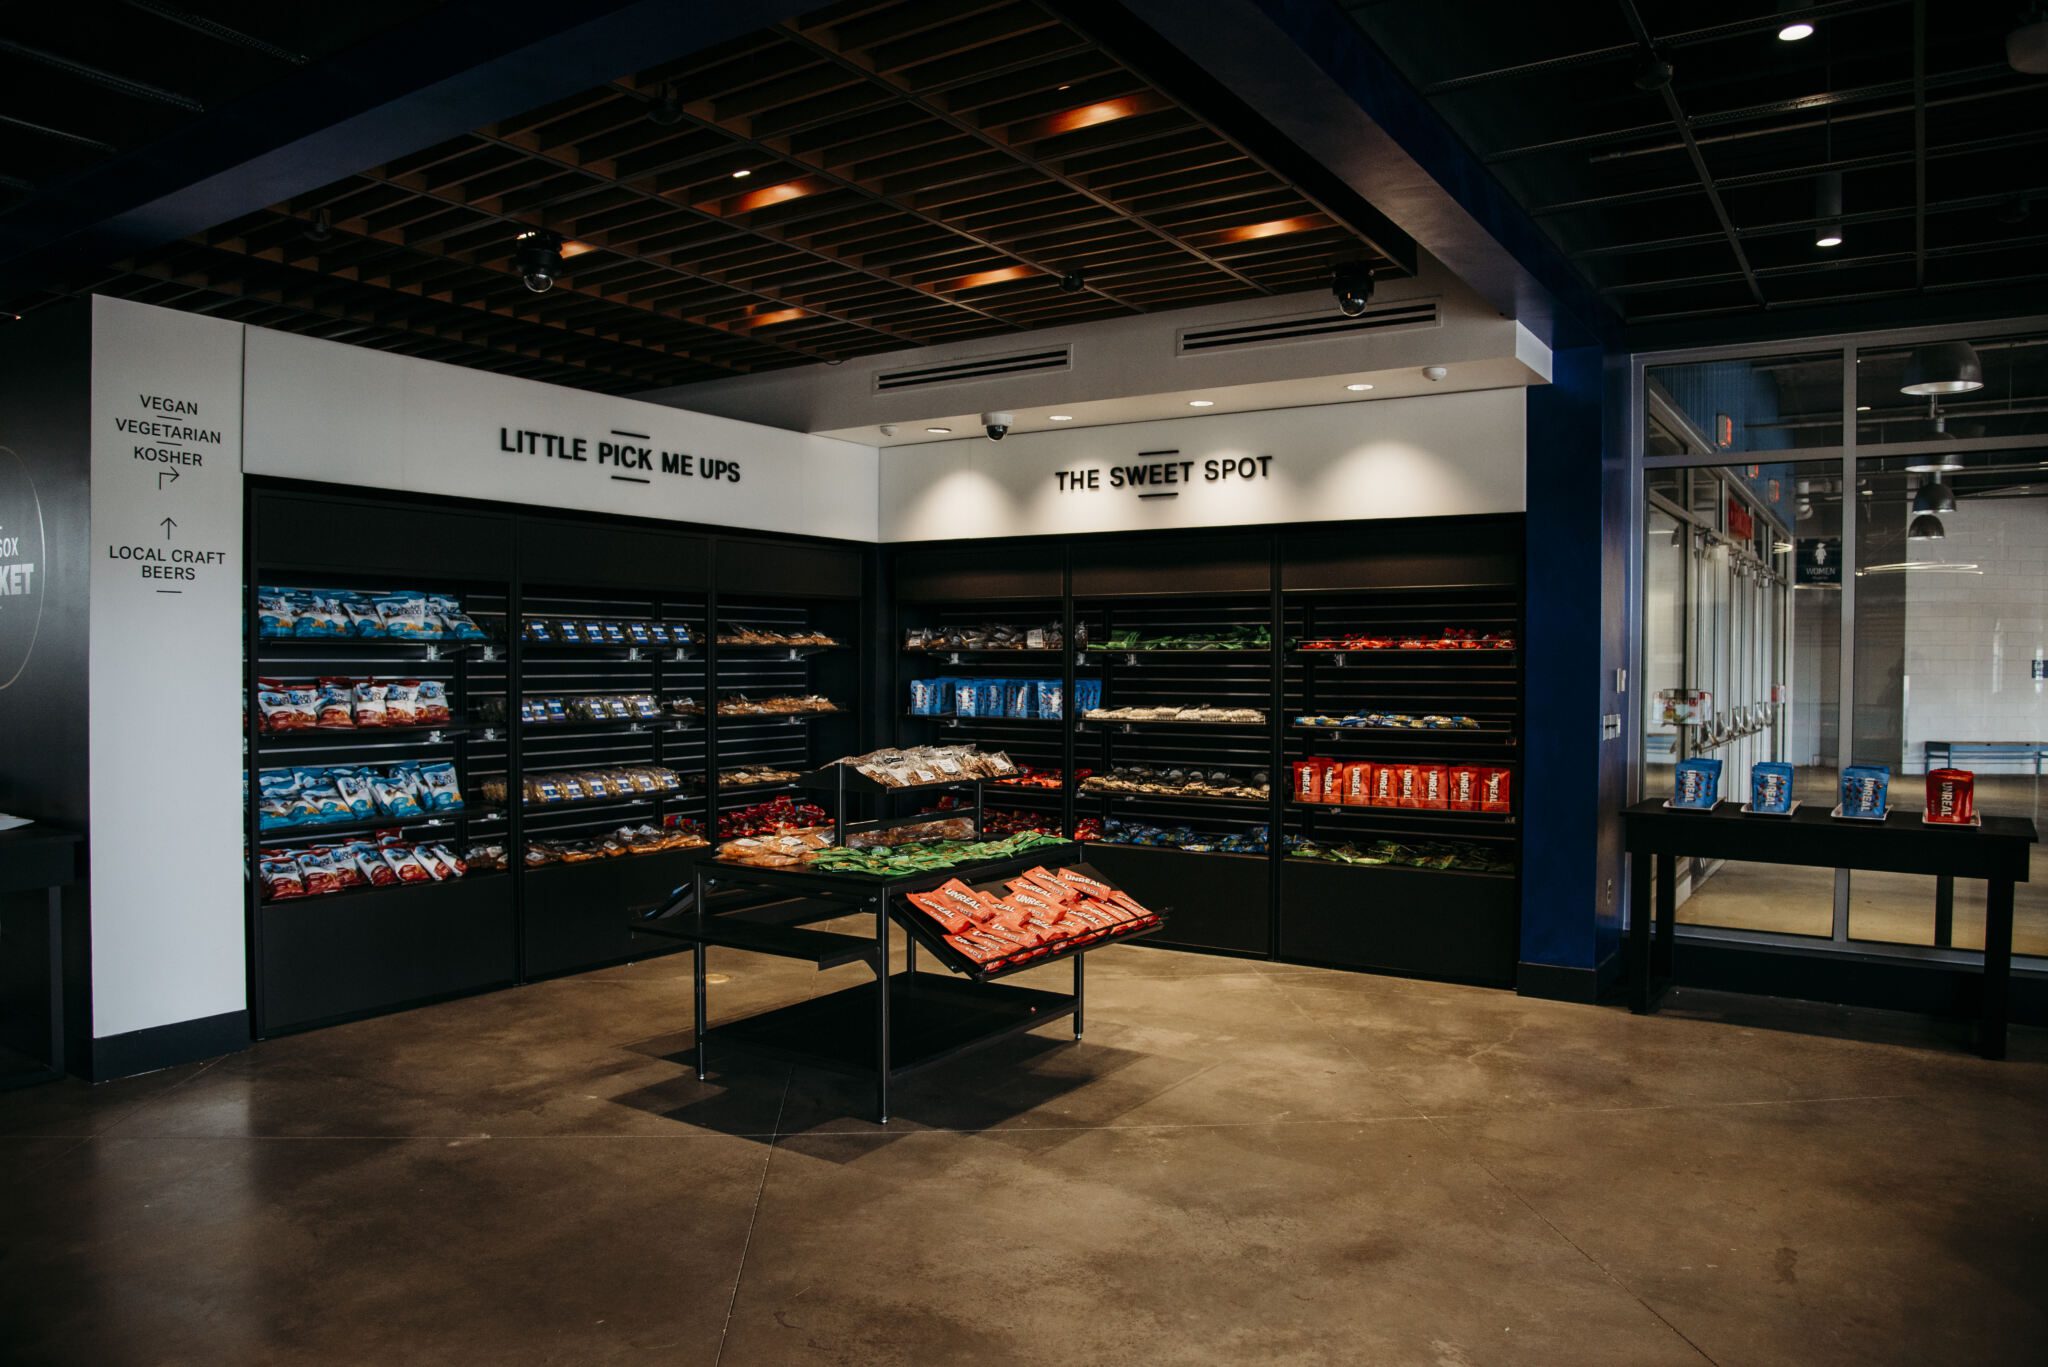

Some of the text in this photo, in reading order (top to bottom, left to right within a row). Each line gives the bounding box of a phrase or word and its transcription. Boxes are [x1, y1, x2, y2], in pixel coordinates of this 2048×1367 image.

[140, 394, 198, 415] VEGAN
[115, 418, 221, 444] VEGETARIAN
[134, 446, 203, 467] KOSHER
[501, 428, 741, 483] LITTLE PICK ME UPS
[1055, 456, 1273, 491] THE SWEET SPOT
[109, 545, 226, 564] LOCAL CRAFT
[142, 565, 196, 581] BEERS
[1806, 567, 1836, 576] WOMEN
[1302, 766, 1311, 795] UNREAL
[1325, 767, 1333, 795] UNREAL
[1352, 767, 1361, 797] UNREAL
[1379, 769, 1389, 799] UNREAL
[1403, 769, 1412, 799] UNREAL
[1428, 770, 1438, 800] UNREAL
[1460, 772, 1469, 802] UNREAL
[1490, 772, 1500, 803] UNREAL
[1685, 770, 1697, 802] UNREAL
[1765, 774, 1778, 807] UNREAL
[1861, 778, 1875, 812] UNREAL
[1941, 782, 1953, 817] UNREAL
[1017, 881, 1053, 898] UNREAL
[1036, 873, 1069, 890] UNREAL
[1064, 873, 1102, 888] UNREAL
[945, 888, 981, 910] UNREAL
[1015, 894, 1050, 910] UNREAL
